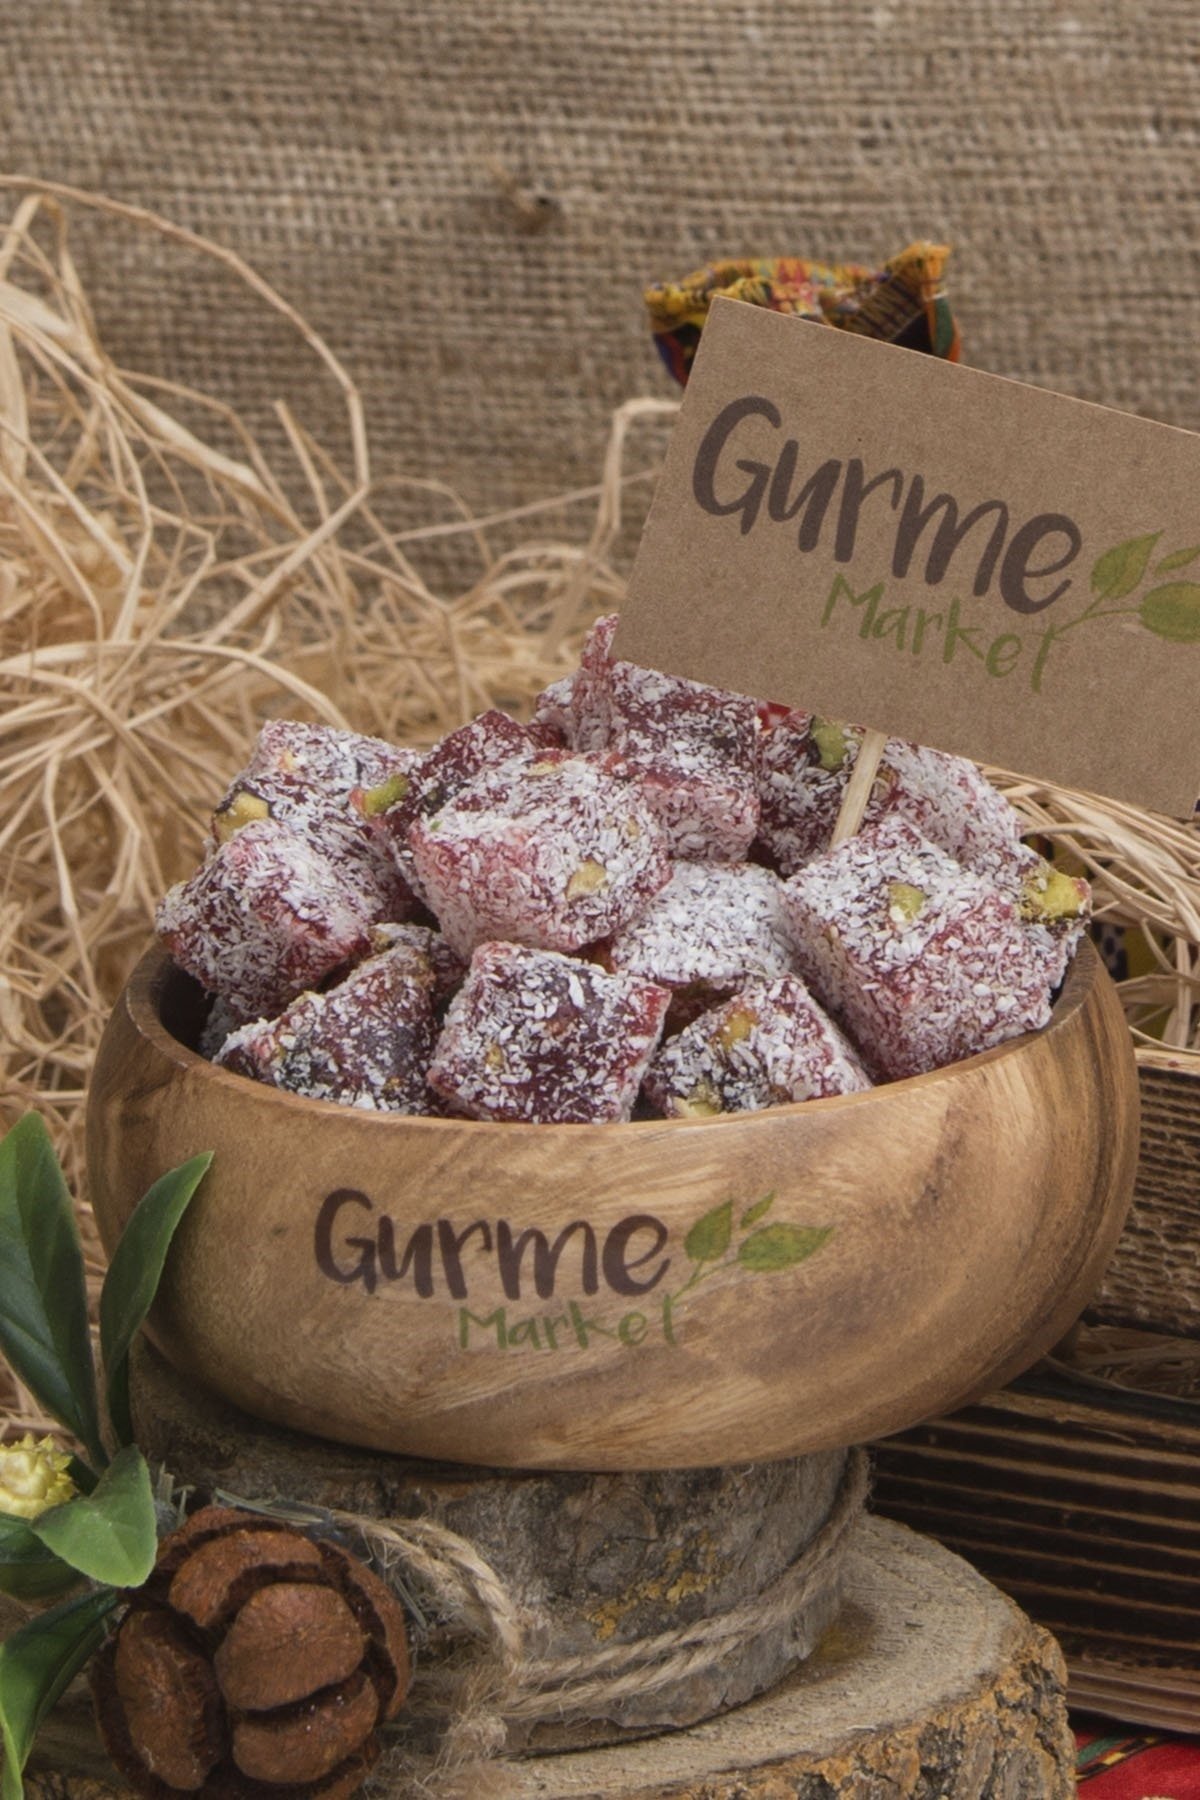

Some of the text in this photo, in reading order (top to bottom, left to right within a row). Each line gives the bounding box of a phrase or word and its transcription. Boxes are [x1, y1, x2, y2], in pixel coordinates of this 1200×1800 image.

[692, 395, 1083, 615] Gurme
[820, 572, 1064, 693] Market
[314, 1188, 672, 1300] Gurme
[459, 1295, 680, 1350] Market
